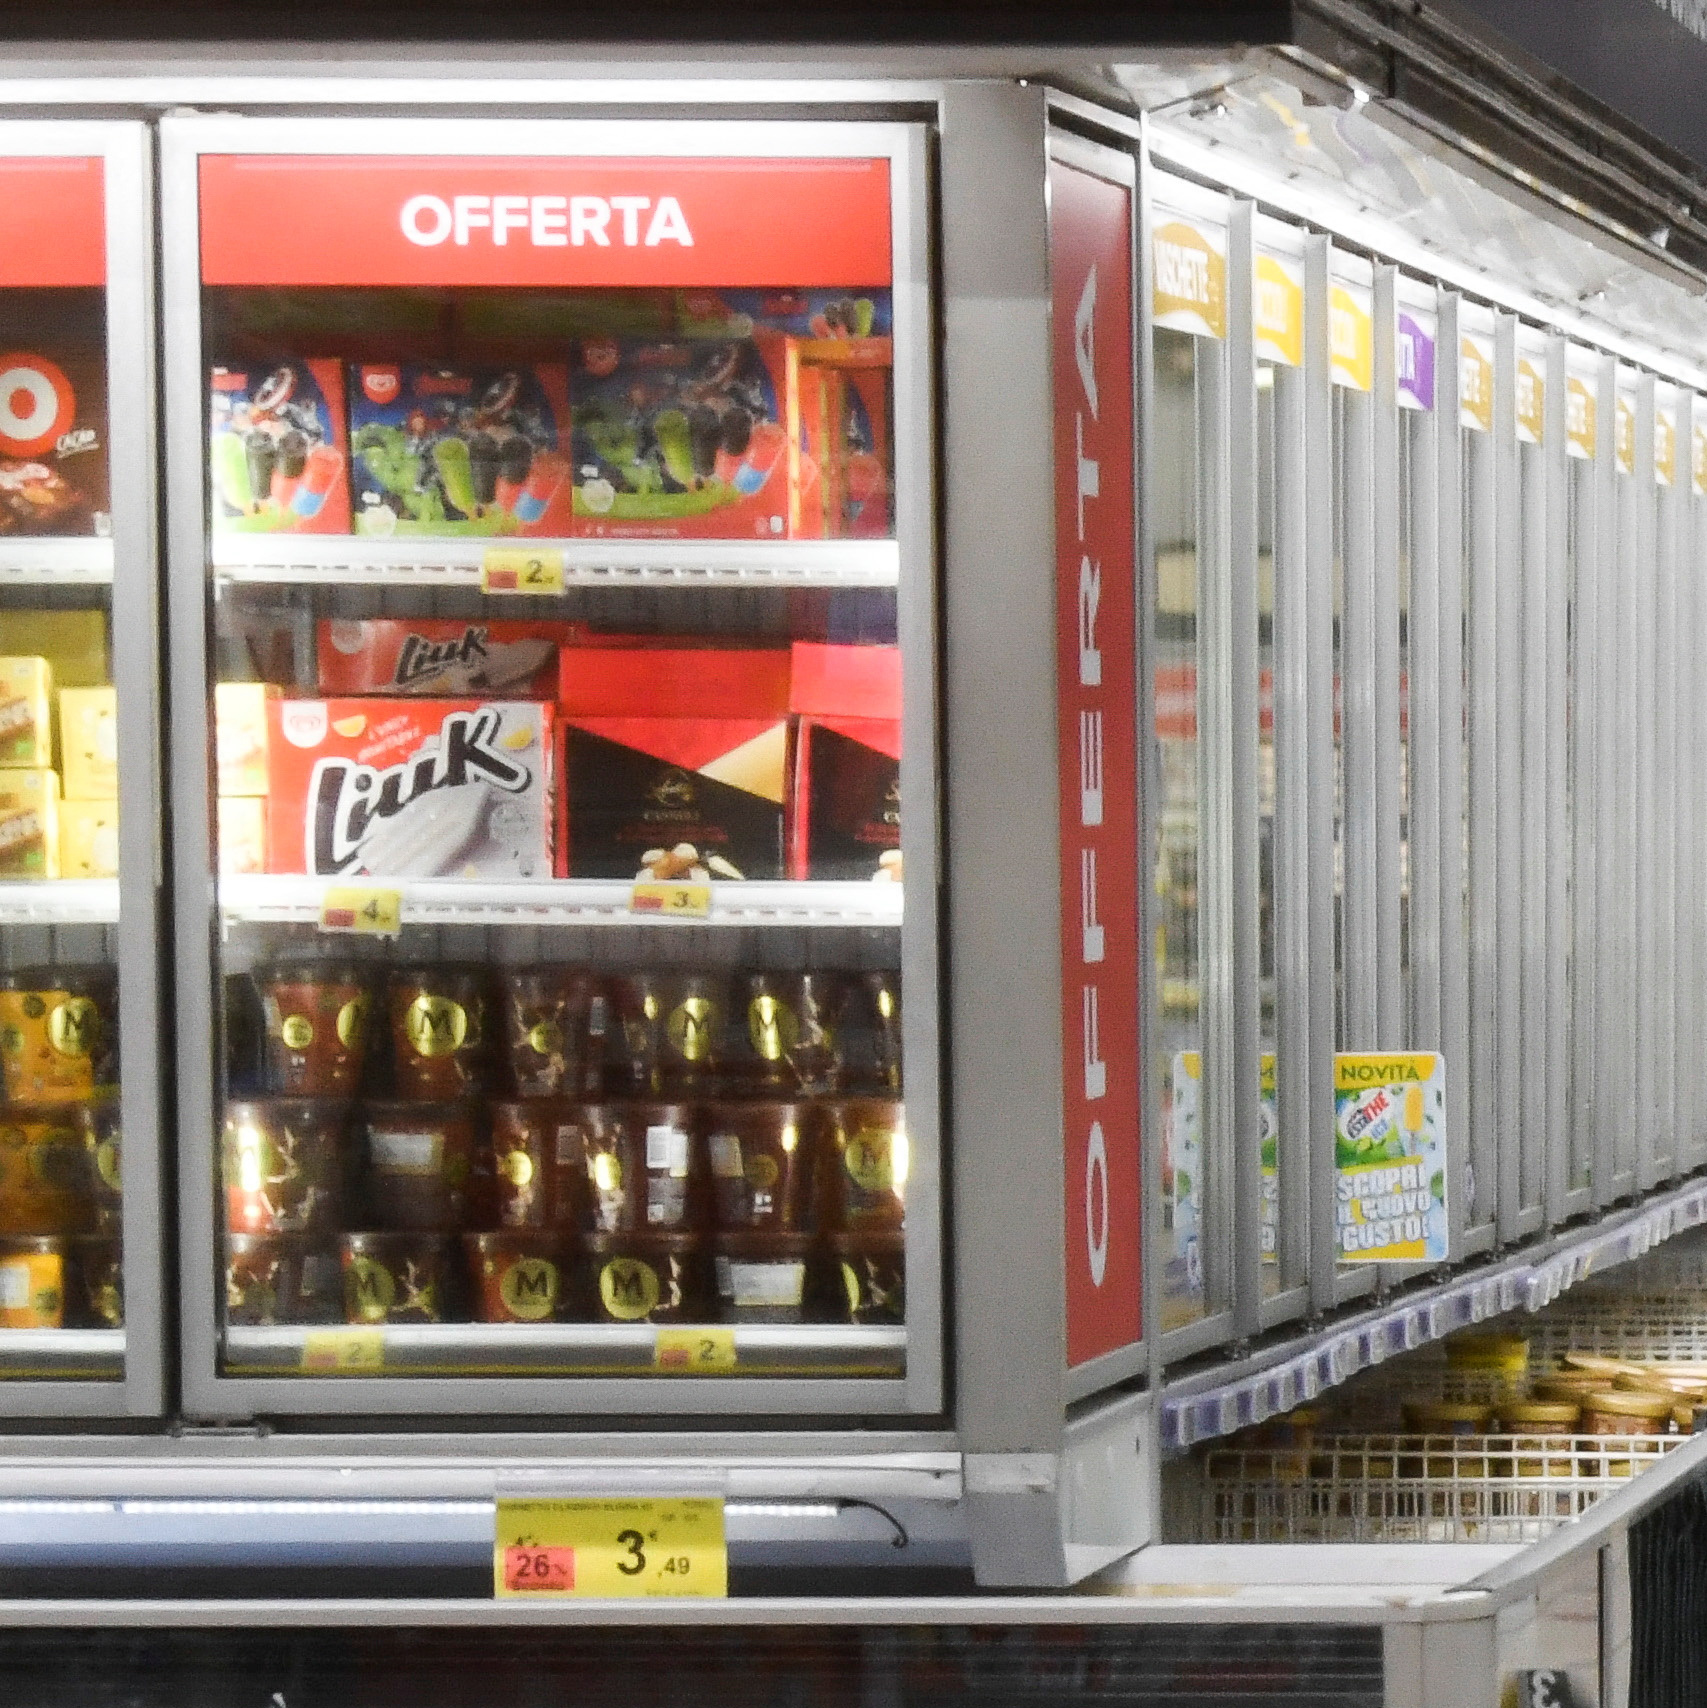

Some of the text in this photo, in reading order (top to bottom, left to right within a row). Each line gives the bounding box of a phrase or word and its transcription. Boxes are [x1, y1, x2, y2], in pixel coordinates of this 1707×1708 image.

[399, 194, 695, 247] OFFERTA
[1074, 262, 1109, 1288] OFFERTA
[1337, 1163, 1427, 1200] SCOPRI
[516, 1270, 547, 1297] M
[612, 1269, 642, 1297] M
